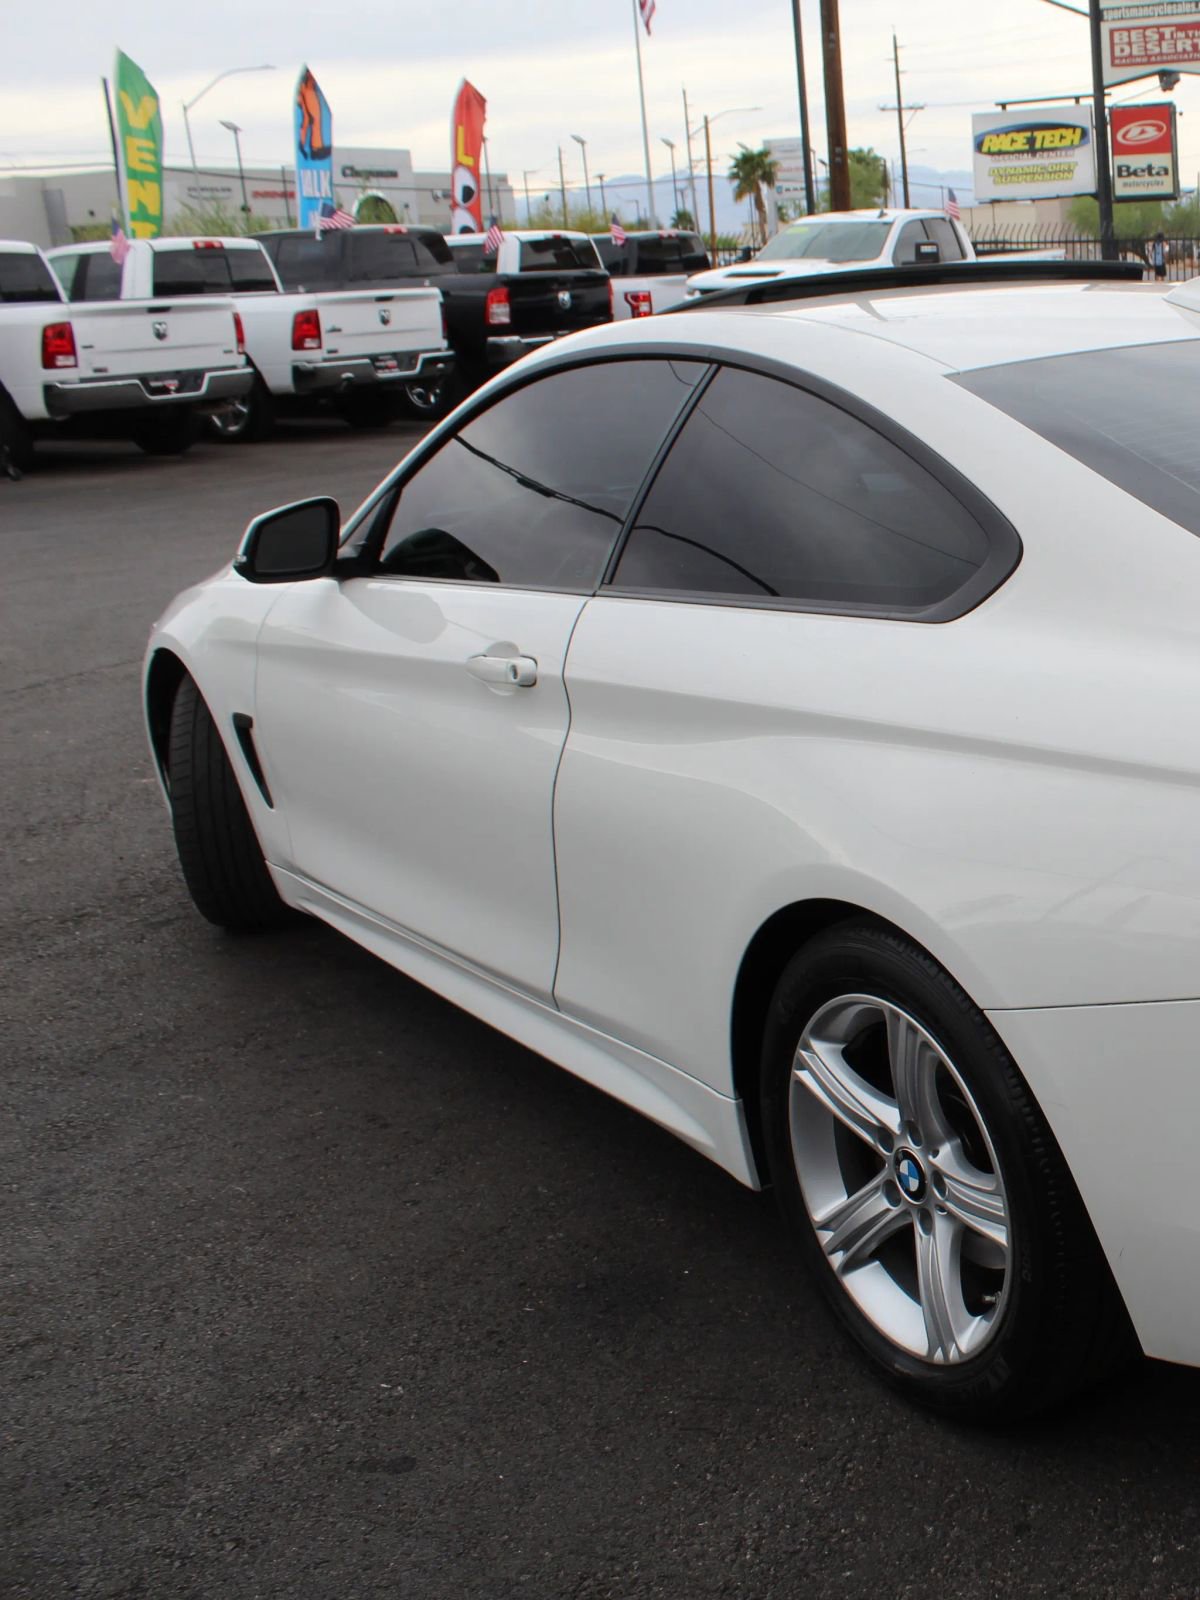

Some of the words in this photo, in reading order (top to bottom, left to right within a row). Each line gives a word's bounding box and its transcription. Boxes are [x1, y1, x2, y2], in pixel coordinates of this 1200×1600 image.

[1113, 26, 1176, 43] BEST
[981, 131, 1031, 153] RACE
[1033, 127, 1082, 150] TECH
[1047, 161, 1078, 173] DIRT
[1117, 163, 1169, 178] Beta
